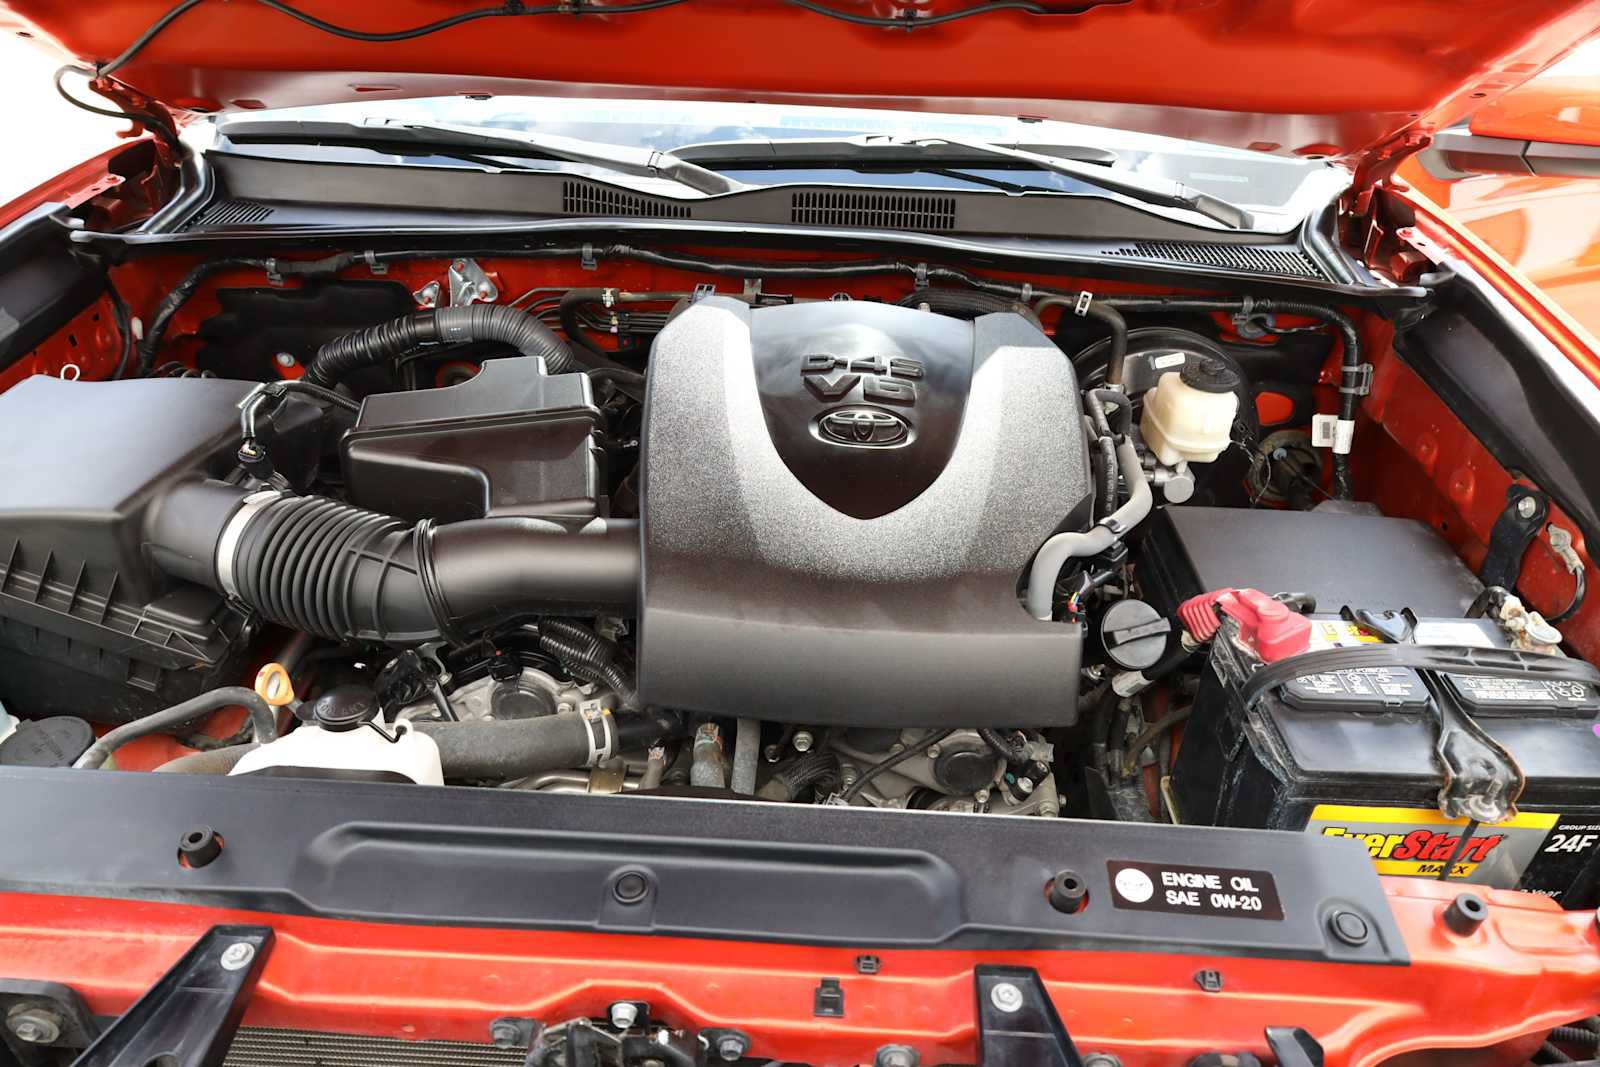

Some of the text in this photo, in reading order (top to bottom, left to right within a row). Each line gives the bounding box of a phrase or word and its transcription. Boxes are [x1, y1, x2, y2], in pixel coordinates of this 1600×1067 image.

[803, 374, 917, 407] V6
[1322, 827, 1503, 862] erStart
[1544, 834, 1598, 853] 24F
[1417, 864, 1469, 874] MAX
[1161, 871, 1222, 890] ENGINE
[1230, 876, 1259, 892] OIL
[1165, 889, 1262, 911] SAE 0W-20
